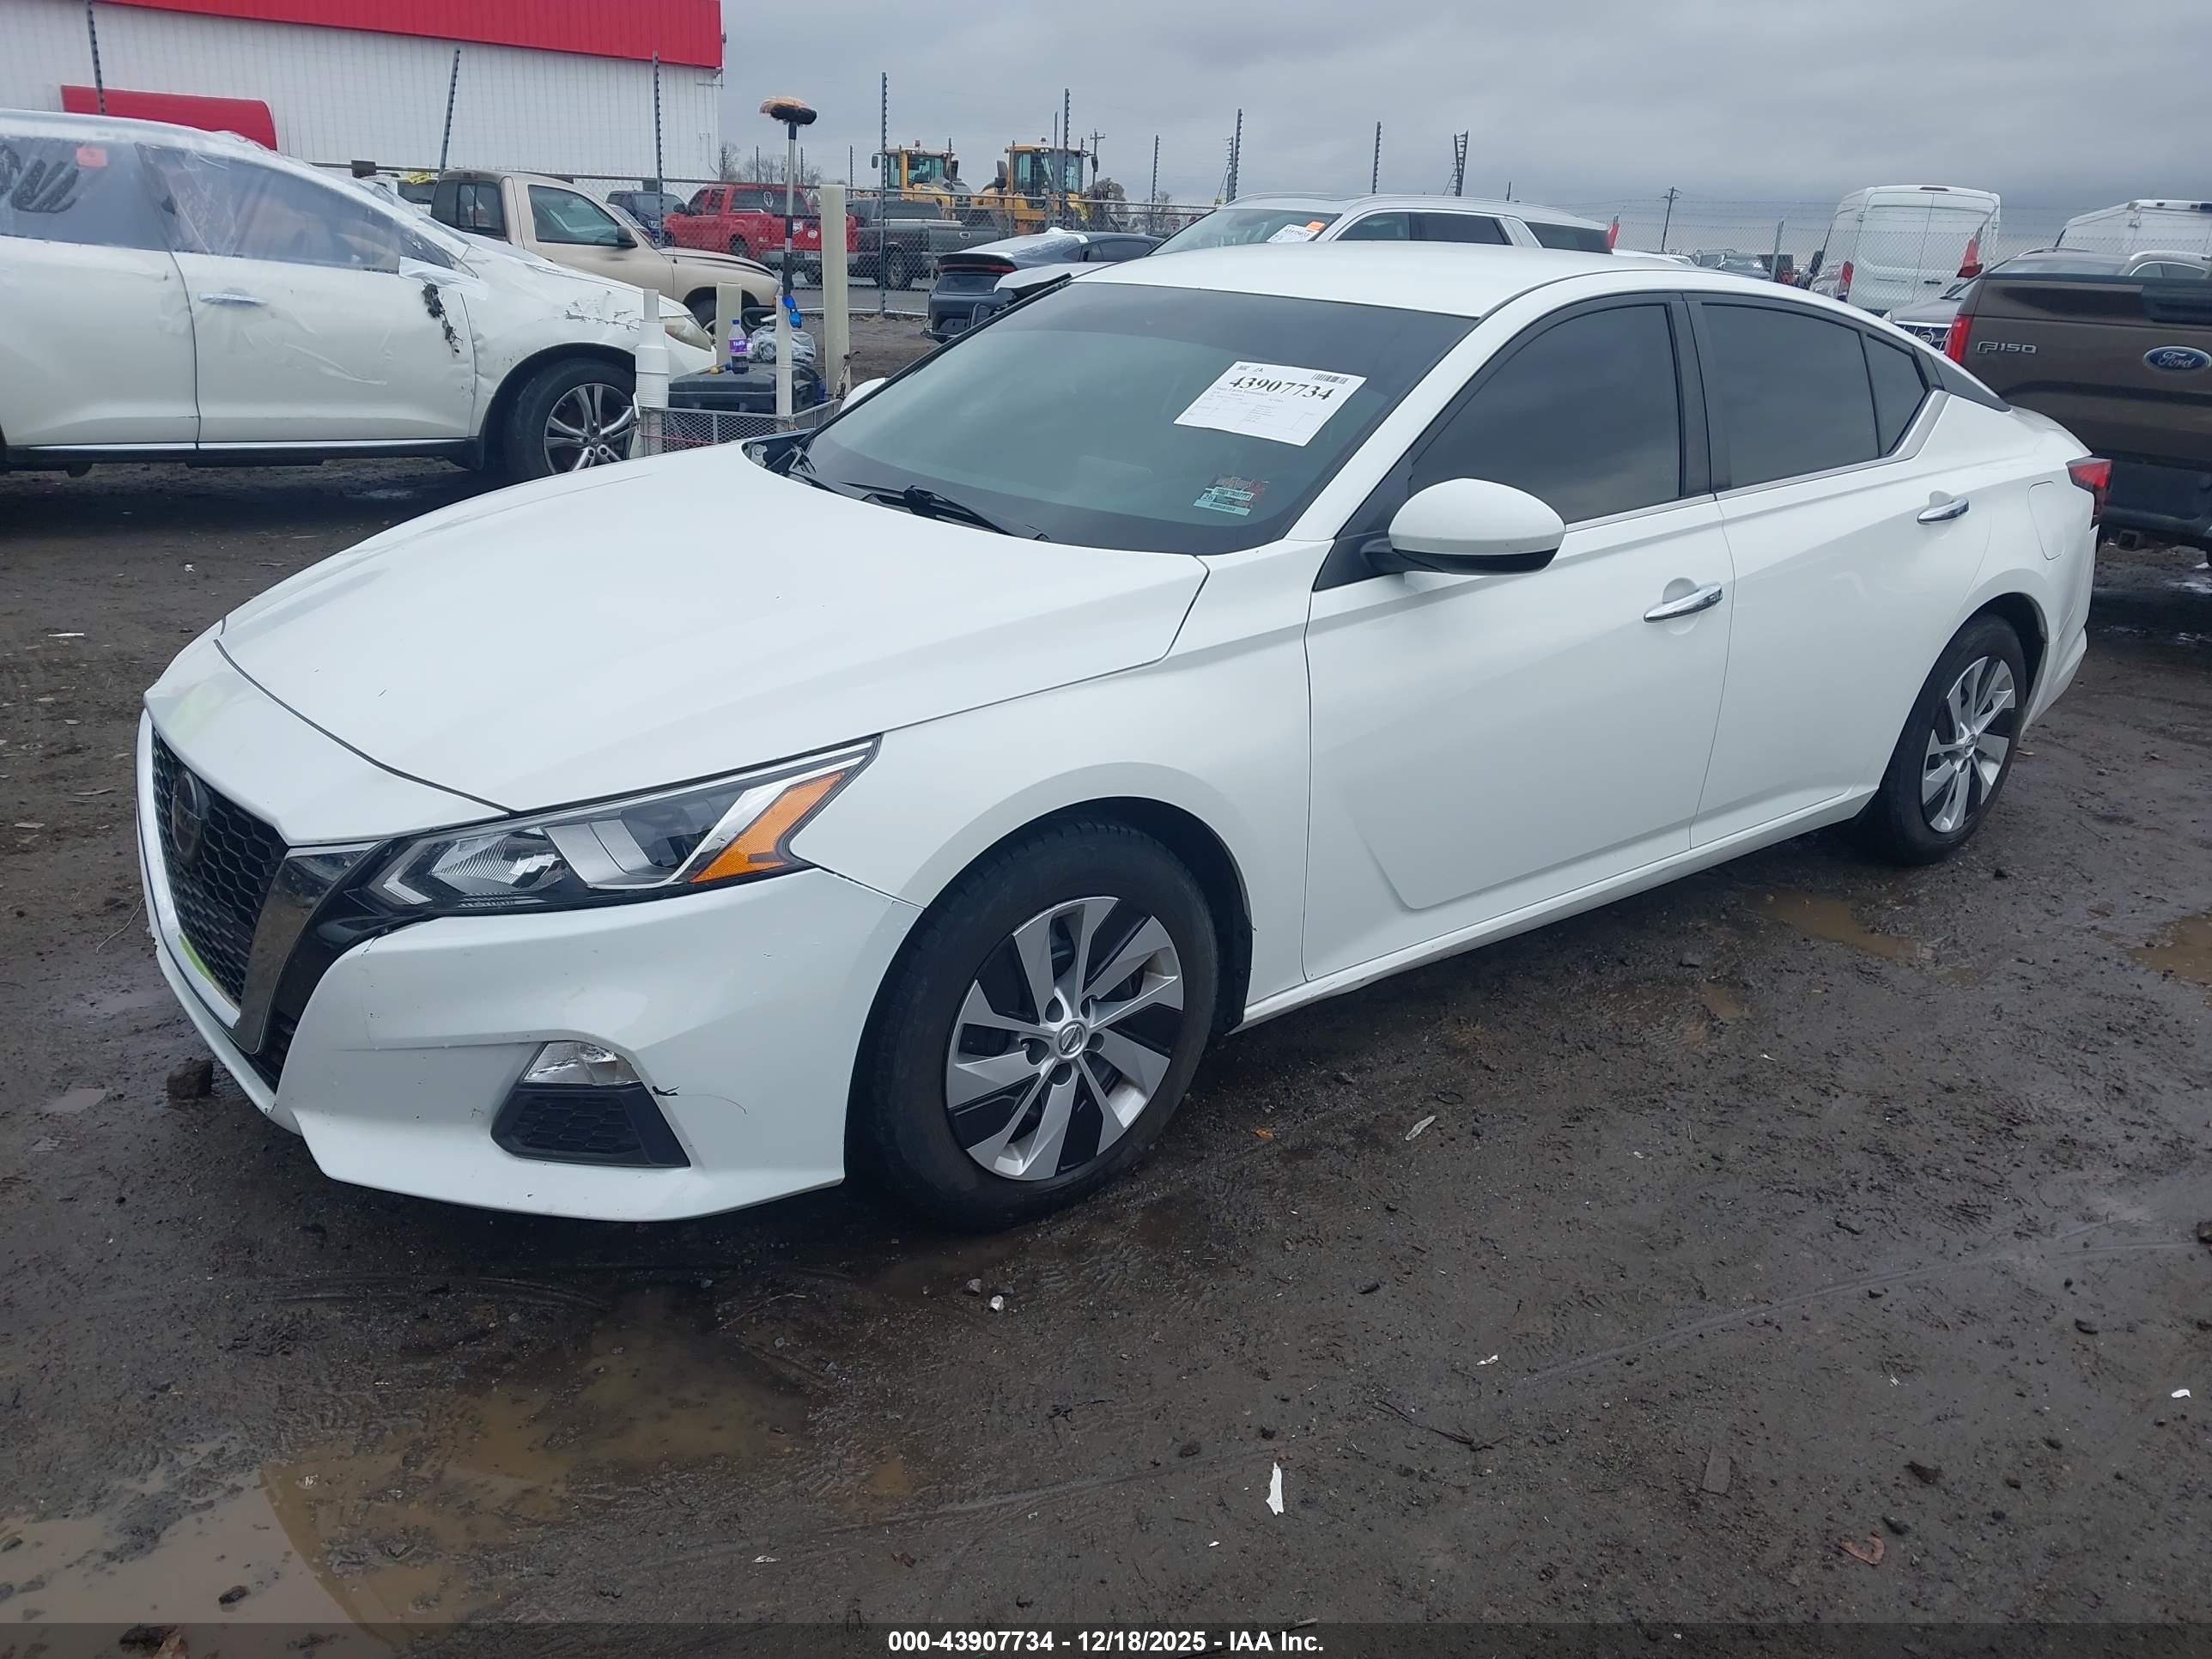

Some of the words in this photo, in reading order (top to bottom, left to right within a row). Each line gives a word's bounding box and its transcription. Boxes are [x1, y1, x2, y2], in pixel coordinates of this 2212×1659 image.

[1978, 341, 2038, 354] F150
[2157, 351, 2197, 368] Ford
[1229, 375, 1336, 400] 43907734
